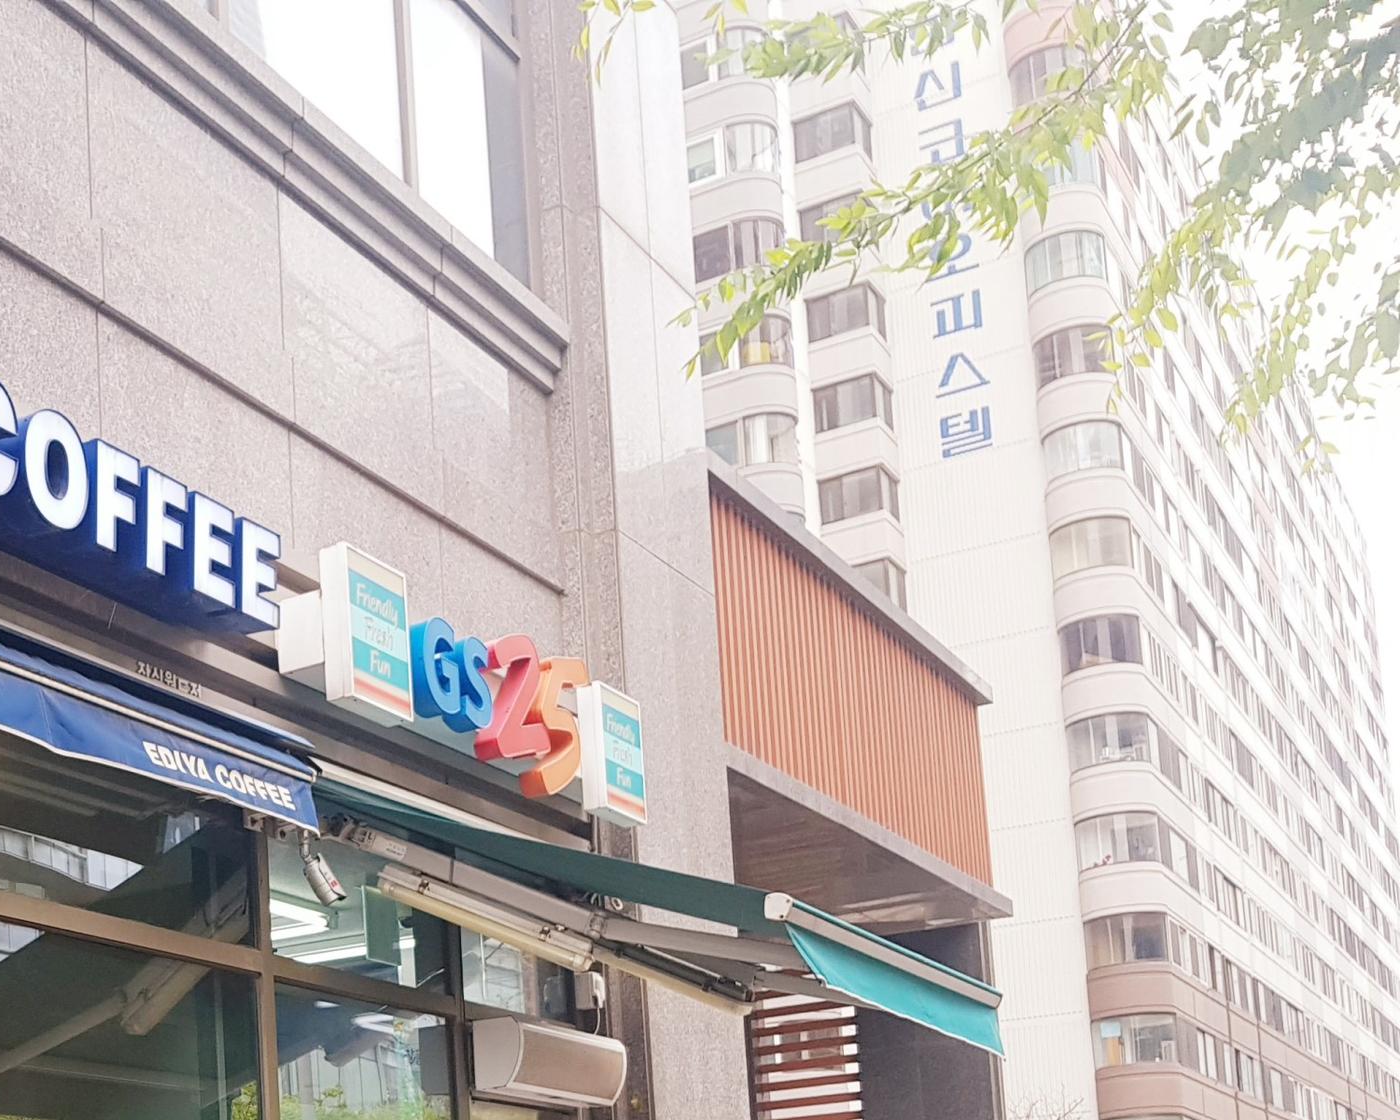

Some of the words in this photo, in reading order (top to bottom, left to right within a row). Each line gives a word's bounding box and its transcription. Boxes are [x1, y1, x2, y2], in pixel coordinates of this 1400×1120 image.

[356, 583, 398, 629] Friendly
[370, 649, 391, 678] Fun
[415, 617, 590, 797] GS25
[142, 741, 214, 783] EDIYA
[215, 764, 296, 810] COFFEE
